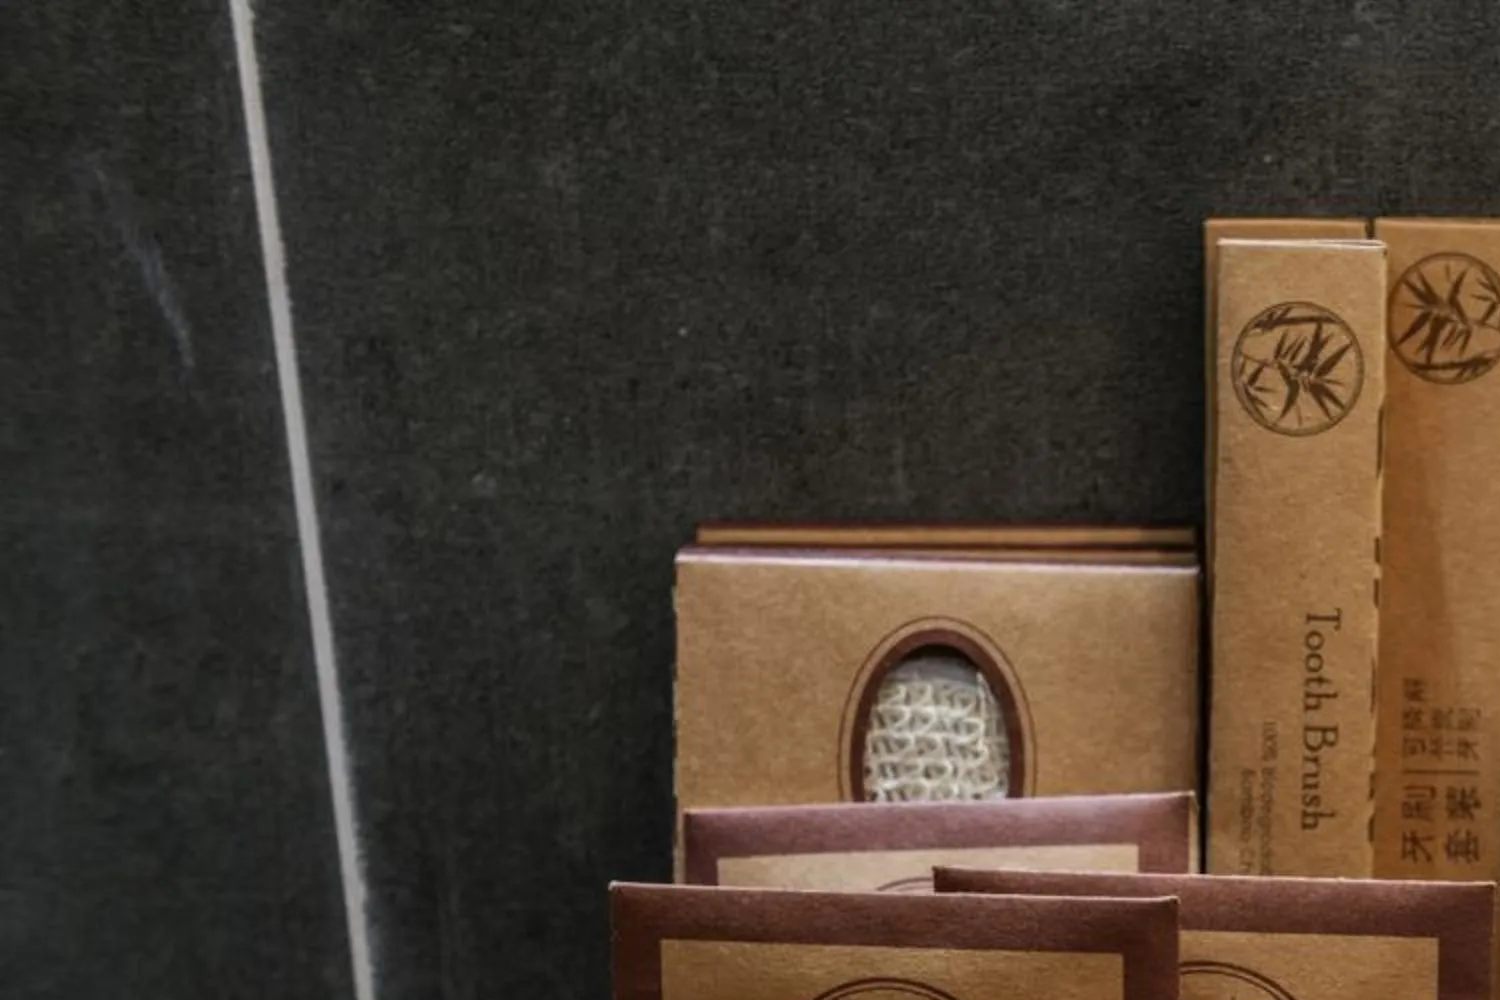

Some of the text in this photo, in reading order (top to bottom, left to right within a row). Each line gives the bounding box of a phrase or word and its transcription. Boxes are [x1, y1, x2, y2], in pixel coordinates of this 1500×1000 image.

[1301, 608, 1343, 831] Tooth Brush
[1402, 785, 1437, 864] 牙刷
